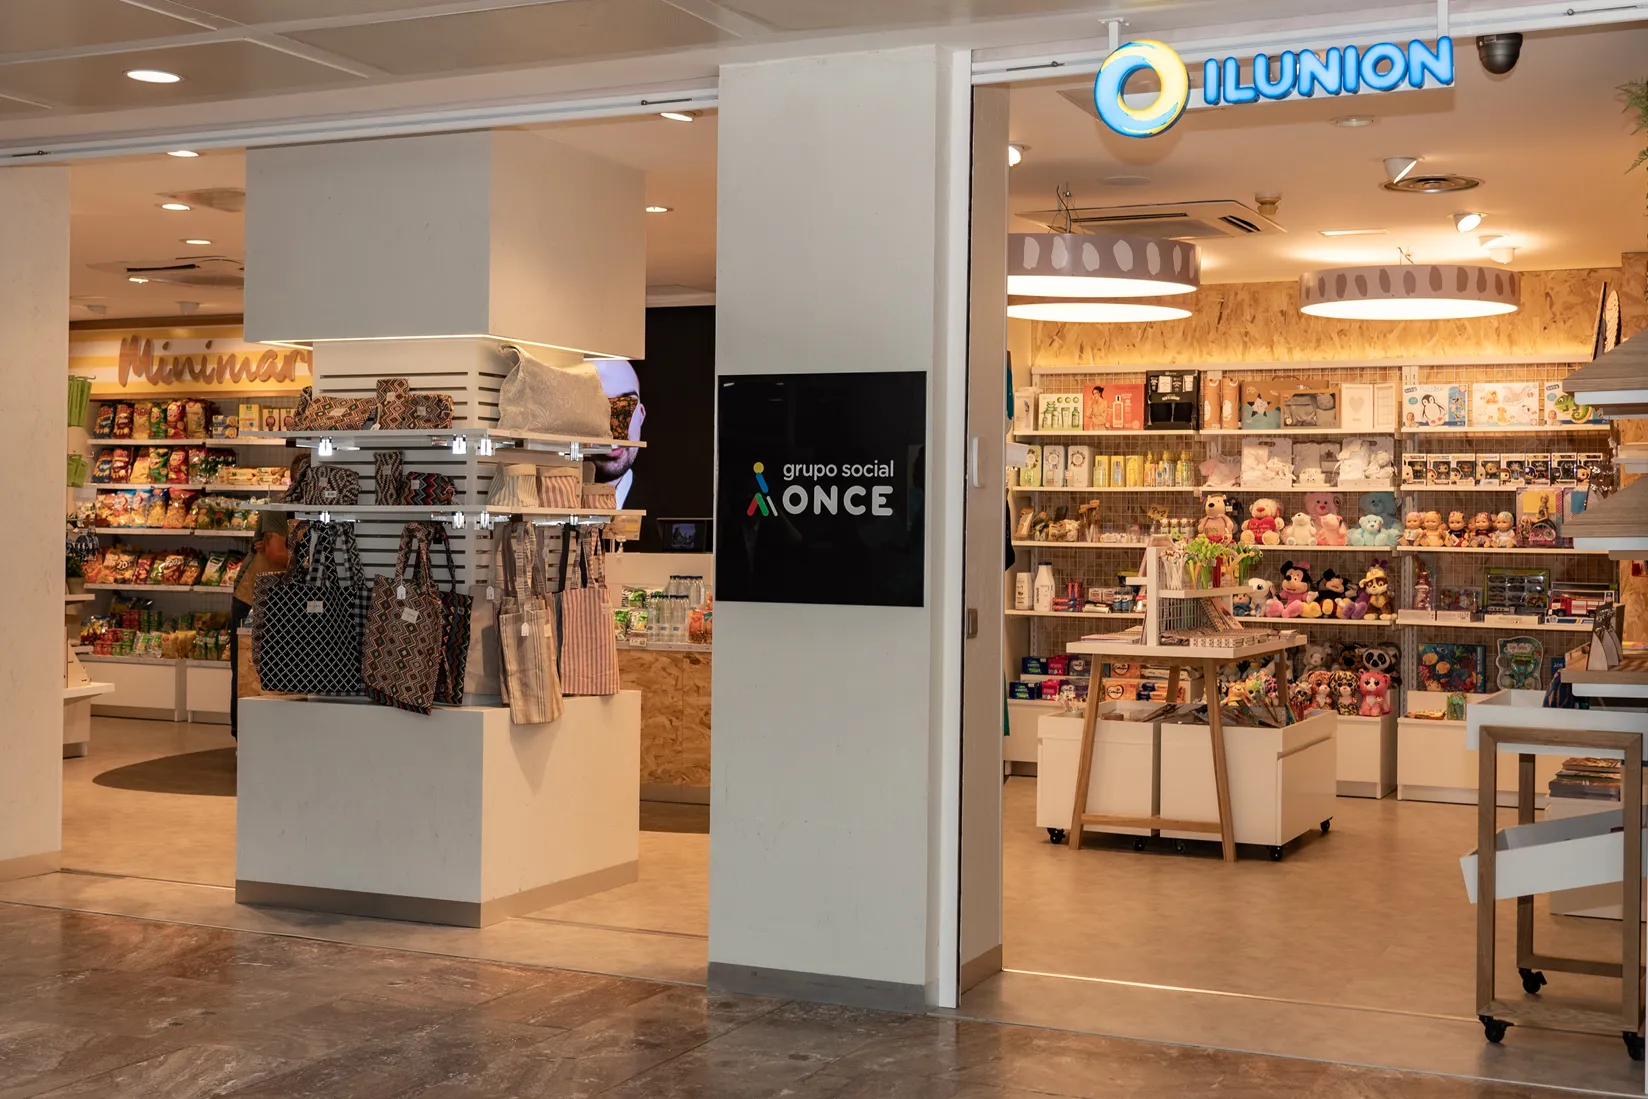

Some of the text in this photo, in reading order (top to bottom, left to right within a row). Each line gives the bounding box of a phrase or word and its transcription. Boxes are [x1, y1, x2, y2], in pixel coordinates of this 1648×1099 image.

[1203, 35, 1455, 106] ILUNION
[118, 335, 313, 388] Minimar
[783, 460, 894, 481] grupo social
[782, 484, 894, 516] ONCE
